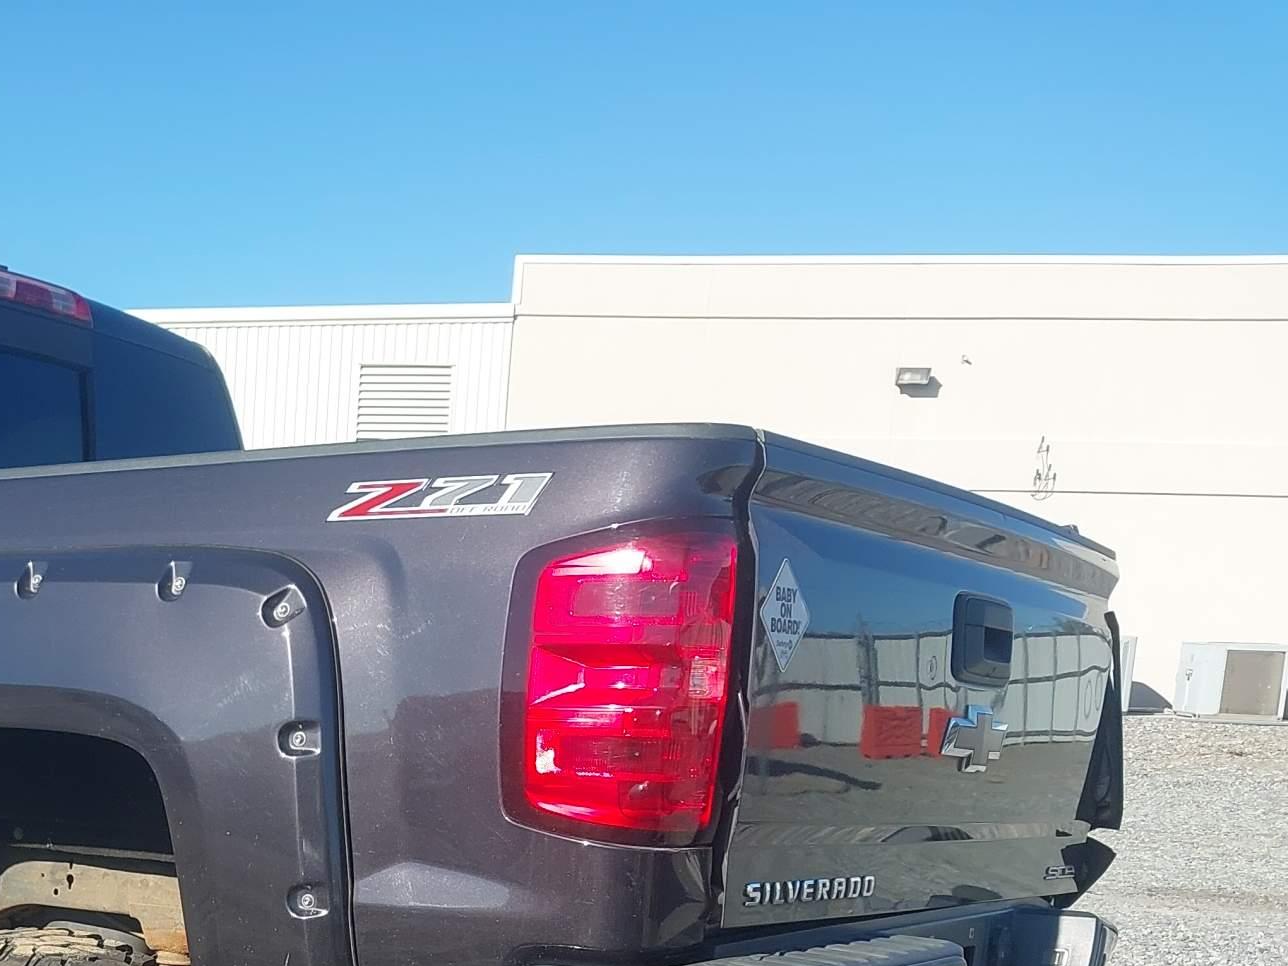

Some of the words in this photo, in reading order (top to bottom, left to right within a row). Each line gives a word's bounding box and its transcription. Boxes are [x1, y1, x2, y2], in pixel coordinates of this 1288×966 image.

[327, 472, 554, 521] Z71
[775, 586, 797, 603] BABY
[780, 603, 792, 618] ON
[743, 876, 875, 907] SILVERADO
